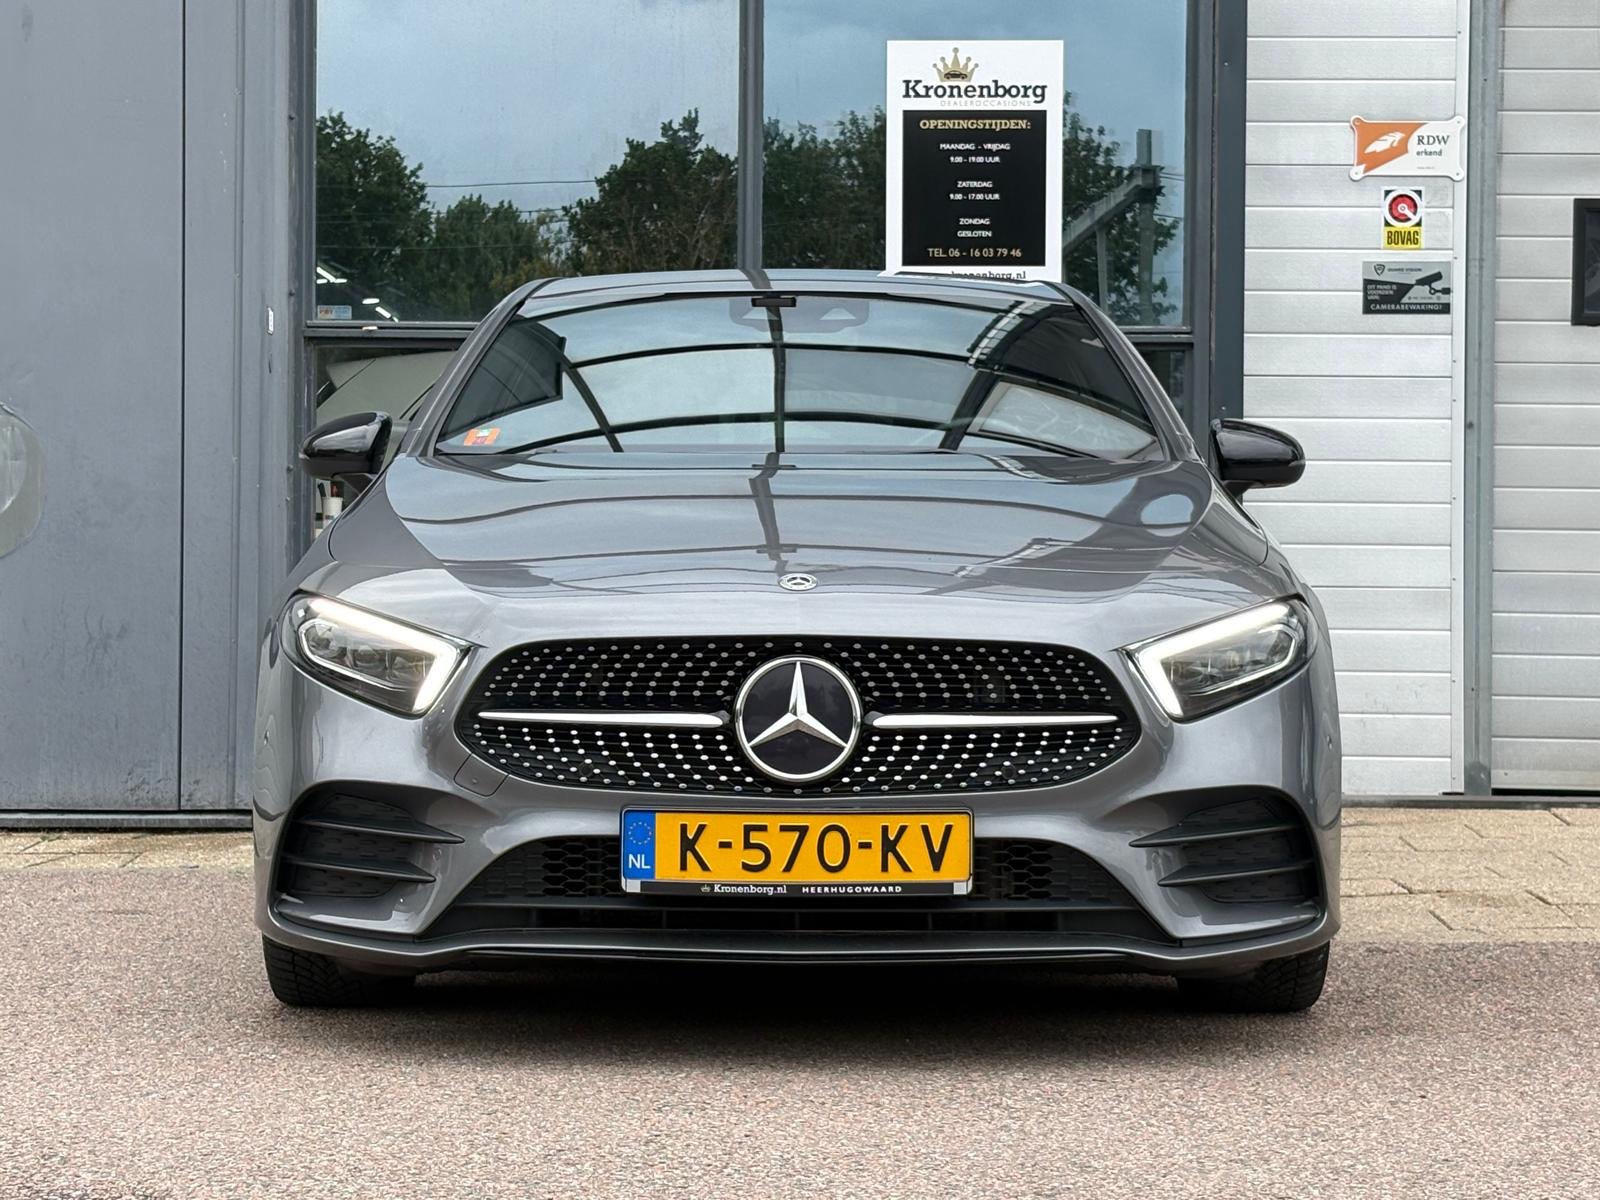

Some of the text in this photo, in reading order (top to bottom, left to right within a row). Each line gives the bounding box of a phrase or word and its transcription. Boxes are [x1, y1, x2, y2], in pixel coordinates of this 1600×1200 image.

[902, 79, 1048, 104] Kronenborg
[919, 119, 1031, 132] OPENINGSTIJDEN:
[1416, 135, 1450, 146] RDW
[982, 143, 1011, 152] VRIJDAG
[1416, 149, 1442, 157] erkend
[1386, 230, 1419, 246] BOVAG
[948, 248, 960, 257] 06
[969, 248, 981, 257] 16
[982, 248, 994, 257] 03
[996, 248, 1008, 257] 79
[1009, 248, 1022, 257] 46
[678, 822, 954, 874] K-570-KV
[627, 853, 651, 870] NL
[713, 884, 903, 895] Kronenborg.nl HEERHUGOWAARD
